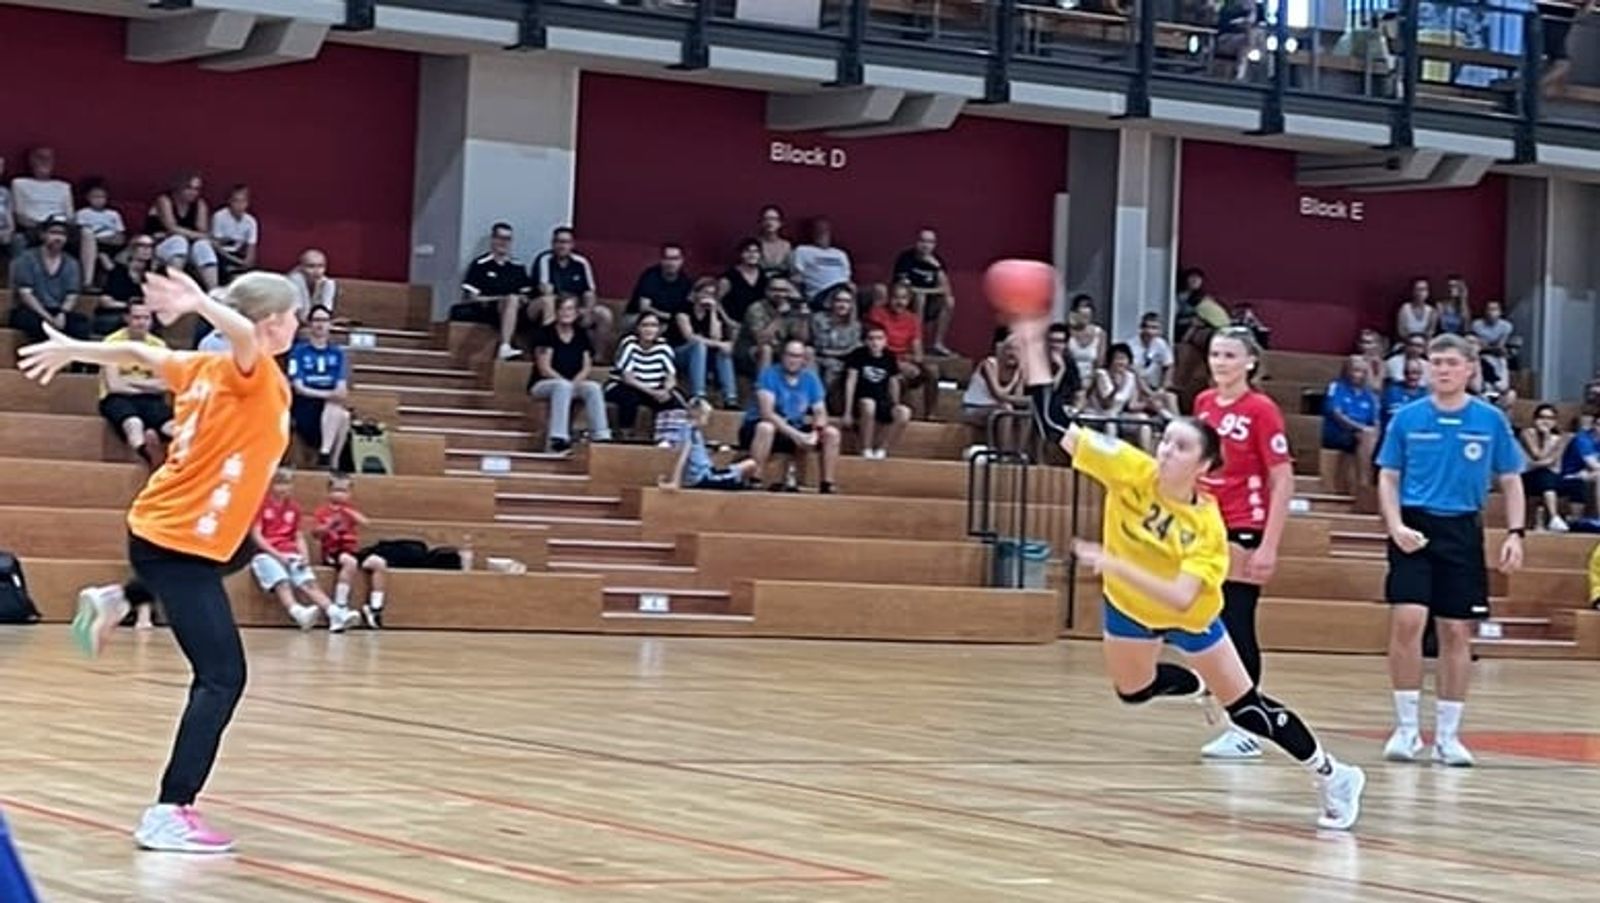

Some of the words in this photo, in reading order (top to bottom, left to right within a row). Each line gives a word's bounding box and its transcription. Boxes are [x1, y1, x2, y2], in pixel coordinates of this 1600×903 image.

[770, 141, 827, 166] Block
[830, 148, 847, 168] D
[1300, 196, 1347, 218] Block
[1351, 201, 1364, 220] E
[1216, 412, 1252, 441] 95
[1142, 502, 1175, 541] 24
